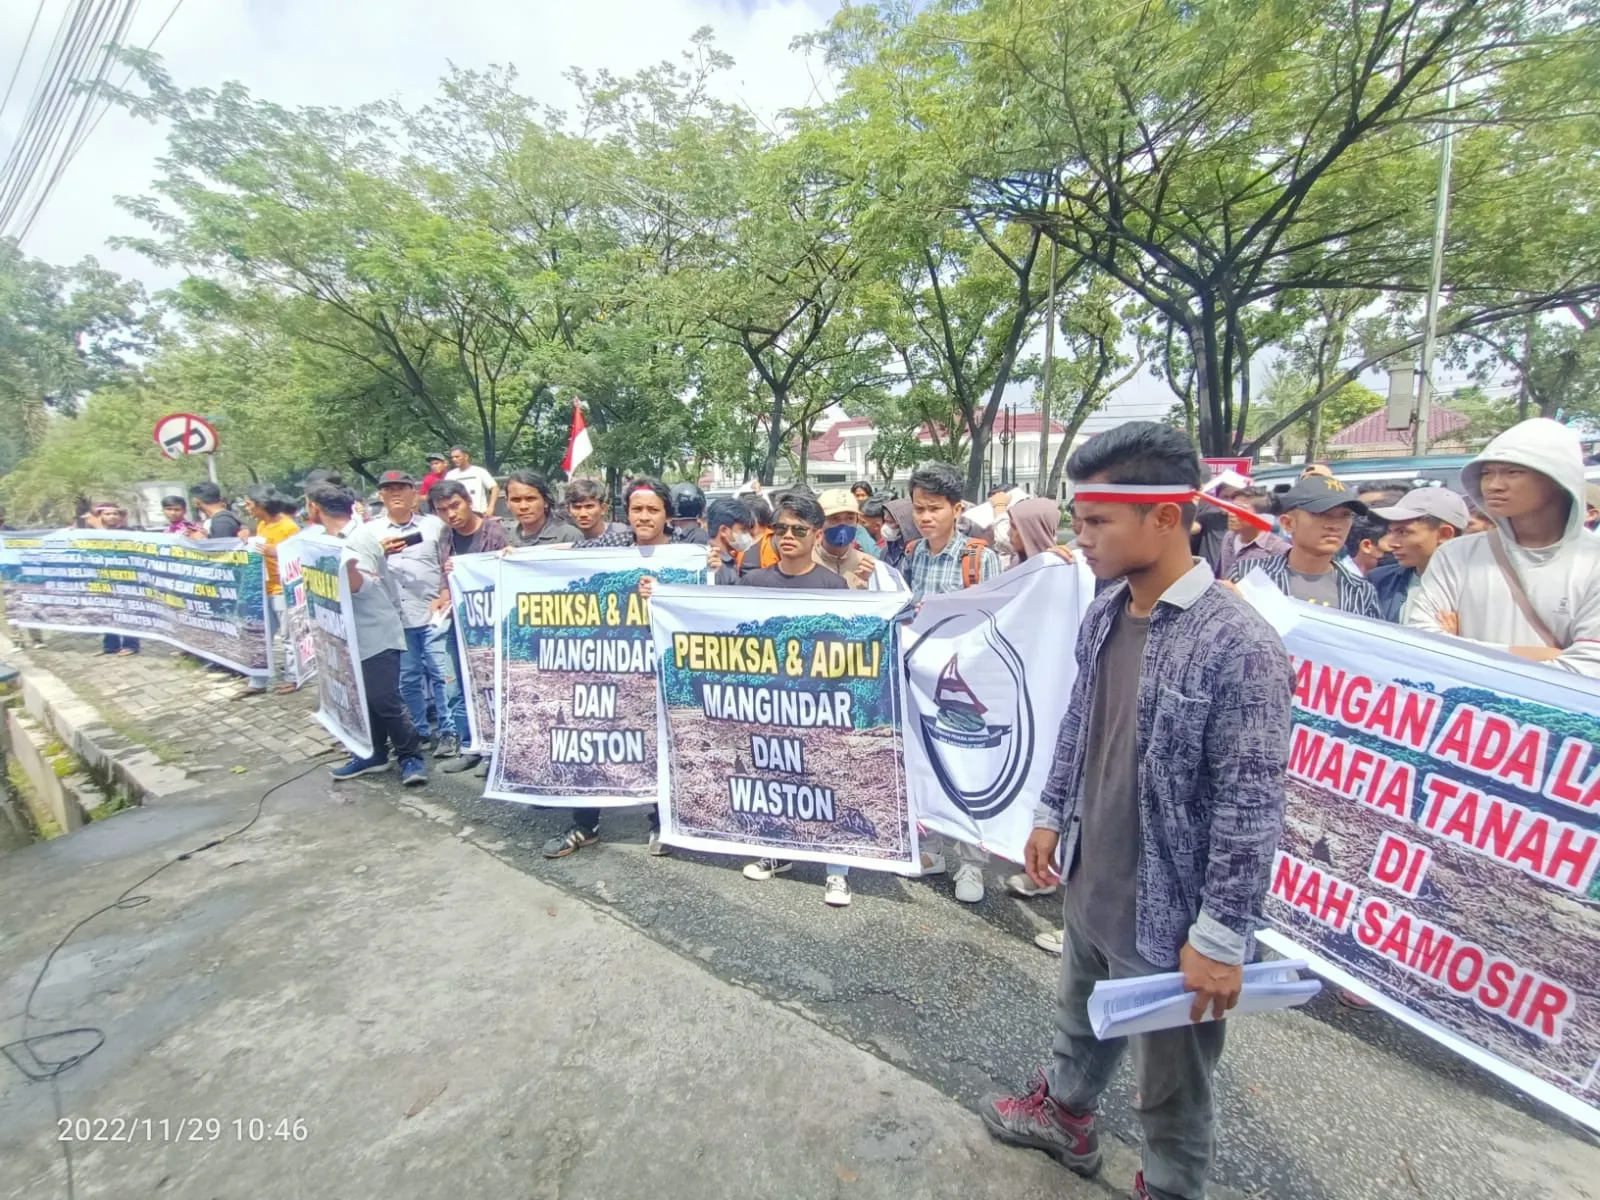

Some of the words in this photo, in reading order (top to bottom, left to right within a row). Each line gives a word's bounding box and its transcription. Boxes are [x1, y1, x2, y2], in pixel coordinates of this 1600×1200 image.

[518, 593, 601, 627] PERIKSA
[606, 594, 621, 626] &
[539, 639, 657, 673] MANGINDAR
[674, 633, 778, 674] PERIKSA
[786, 640, 804, 677] &
[810, 640, 881, 679] ADILI
[574, 684, 616, 719] DAN
[702, 684, 853, 728] MANGINDAR
[1289, 654, 1437, 748] ANGAN
[1436, 709, 1543, 787] ADA
[551, 730, 643, 764] WASTON
[752, 735, 803, 774] DAN
[730, 778, 835, 822] WASTON
[1288, 727, 1414, 817] MAFIA
[1424, 779, 1597, 888] TANAH
[1374, 835, 1428, 895] DI
[1358, 900, 1570, 1039] SAMOSIR
